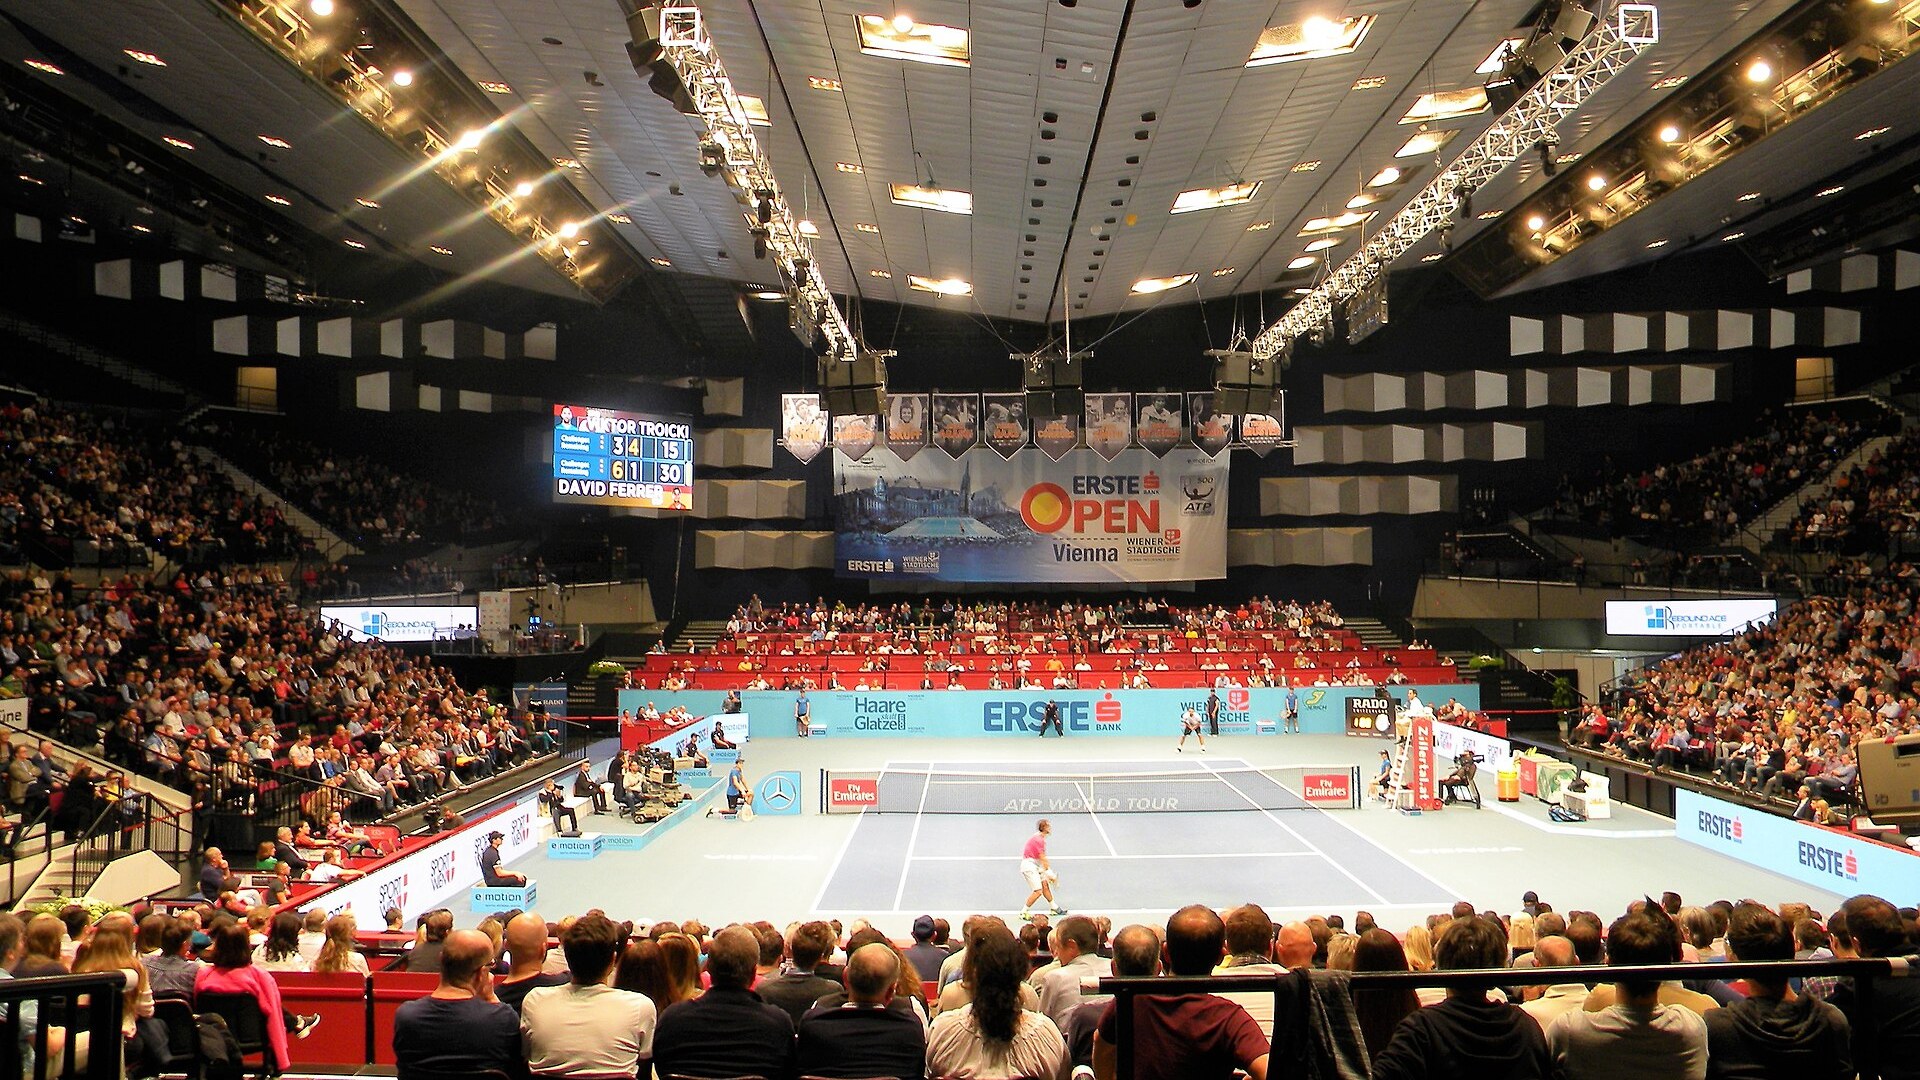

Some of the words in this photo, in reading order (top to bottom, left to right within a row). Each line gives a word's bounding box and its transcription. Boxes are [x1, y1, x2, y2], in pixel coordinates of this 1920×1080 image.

[639, 420, 689, 439] TROICKI
[613, 437, 624, 456] 3
[629, 438, 640, 456] 4
[661, 441, 679, 459] 15
[612, 460, 624, 480] 6
[630, 462, 638, 480] 1
[660, 464, 681, 483] 30
[558, 479, 607, 497] DAVID
[1073, 476, 1140, 494] ERSTE
[1020, 482, 1161, 534] OPEN
[1184, 502, 1212, 511] ATP
[1126, 537, 1164, 546] WIENER
[1052, 543, 1119, 562] Vienna
[847, 560, 884, 572] ERSTE
[855, 697, 906, 713] Haare
[1180, 702, 1227, 711] WIER
[1352, 698, 1388, 709] RADO
[854, 715, 897, 730] Glatze
[1096, 723, 1122, 731] BANK
[1418, 725, 1430, 800] Zillertal.at
[847, 783, 861, 792] Fly
[1320, 780, 1333, 788] Fly
[833, 791, 875, 802] Emirates
[1305, 786, 1347, 797] Emirates
[1003, 798, 1043, 811] ATP
[1050, 798, 1121, 811] WORLD
[1127, 797, 1179, 810] TOUR
[1698, 810, 1732, 841] ERSTE
[559, 842, 591, 850] motion
[1798, 840, 1844, 877] ERSTE
[379, 876, 402, 903] SPORT
[485, 892, 522, 901] motion
